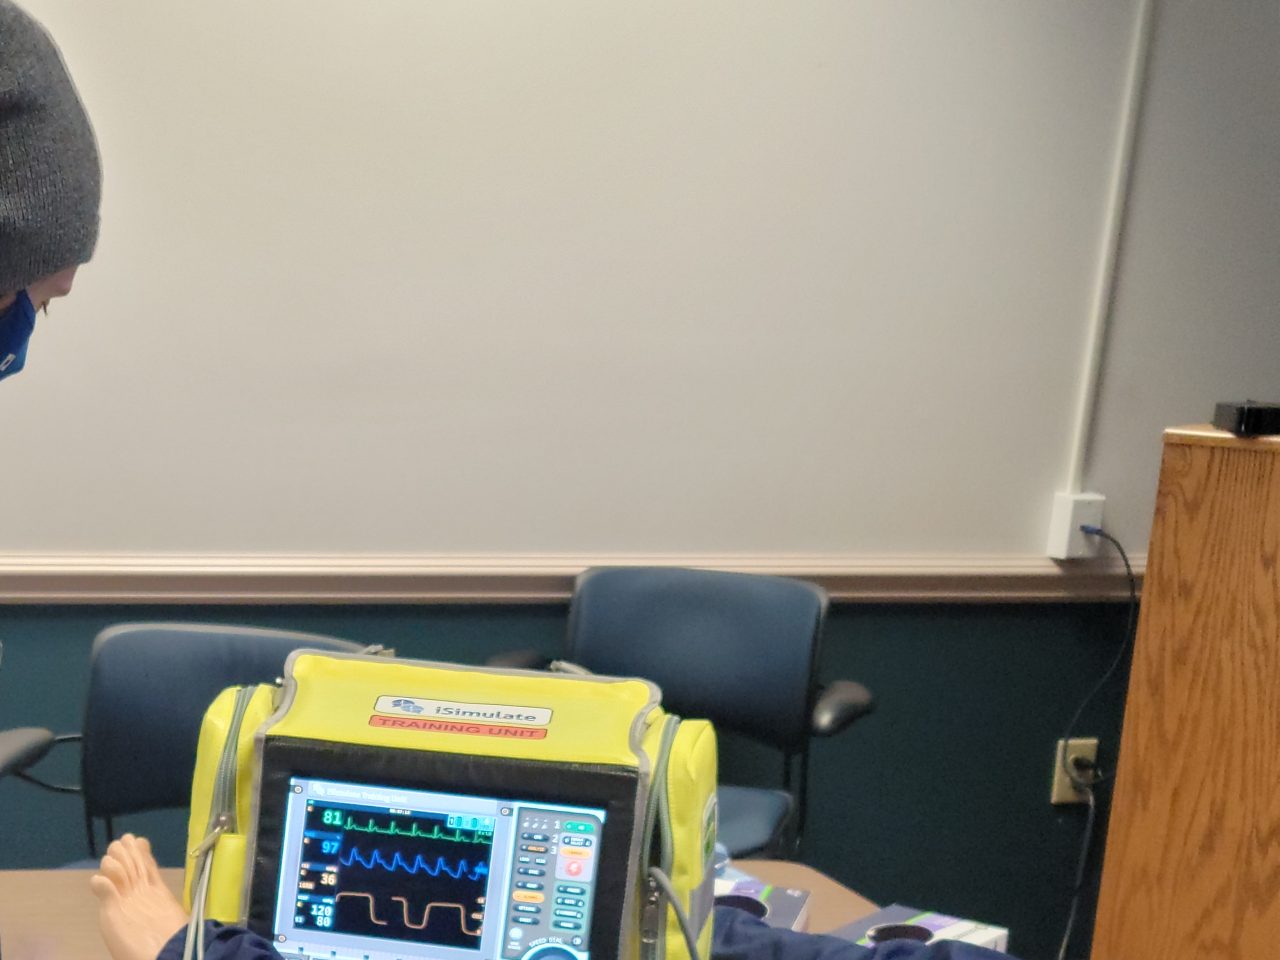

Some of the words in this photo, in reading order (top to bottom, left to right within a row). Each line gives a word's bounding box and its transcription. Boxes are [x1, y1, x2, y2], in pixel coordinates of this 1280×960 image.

[435, 706, 537, 721] iSimulate
[379, 718, 481, 734] TRAINING
[488, 729, 539, 739] UNIT
[323, 809, 342, 825] 81
[552, 834, 558, 843] 2
[322, 841, 339, 854] 97
[550, 846, 557, 854] 3
[320, 872, 337, 885] 36
[311, 904, 333, 916] 120
[316, 916, 332, 927] 80
